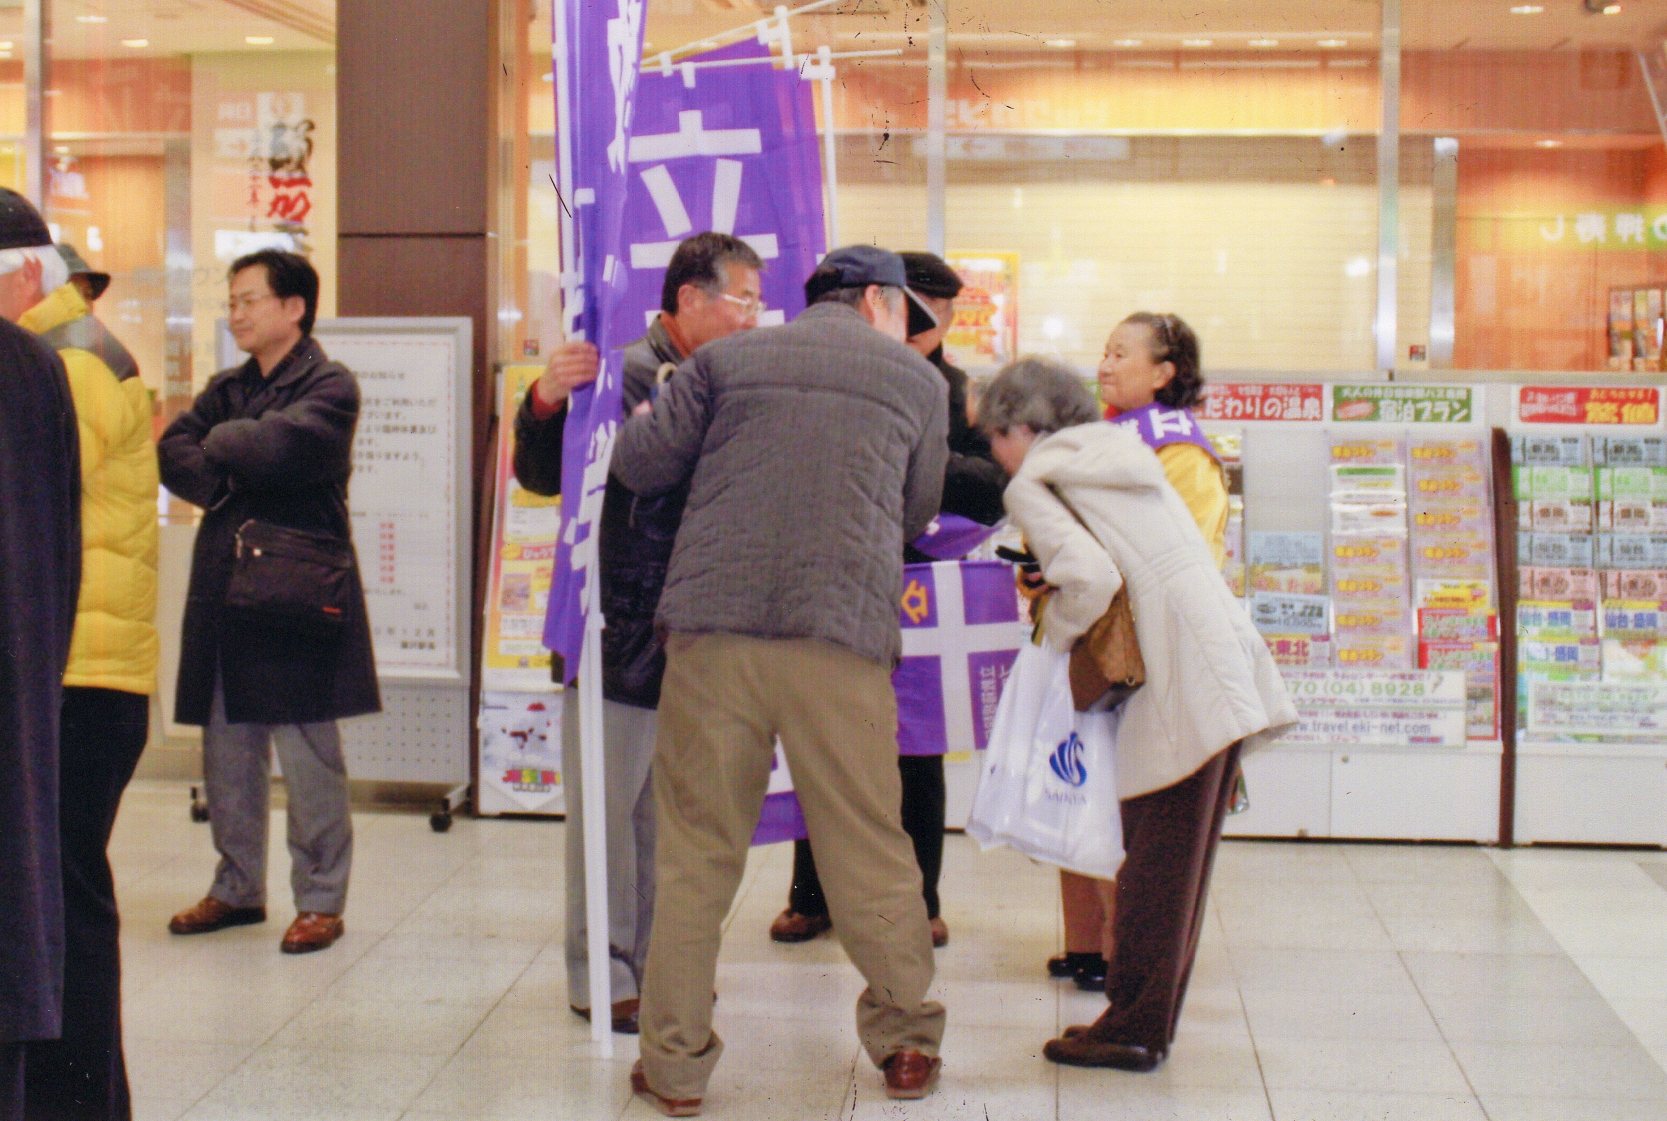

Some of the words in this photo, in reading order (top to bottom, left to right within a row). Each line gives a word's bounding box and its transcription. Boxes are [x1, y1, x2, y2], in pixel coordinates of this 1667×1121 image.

[1193, 396, 1321, 420] だわりの温泉
